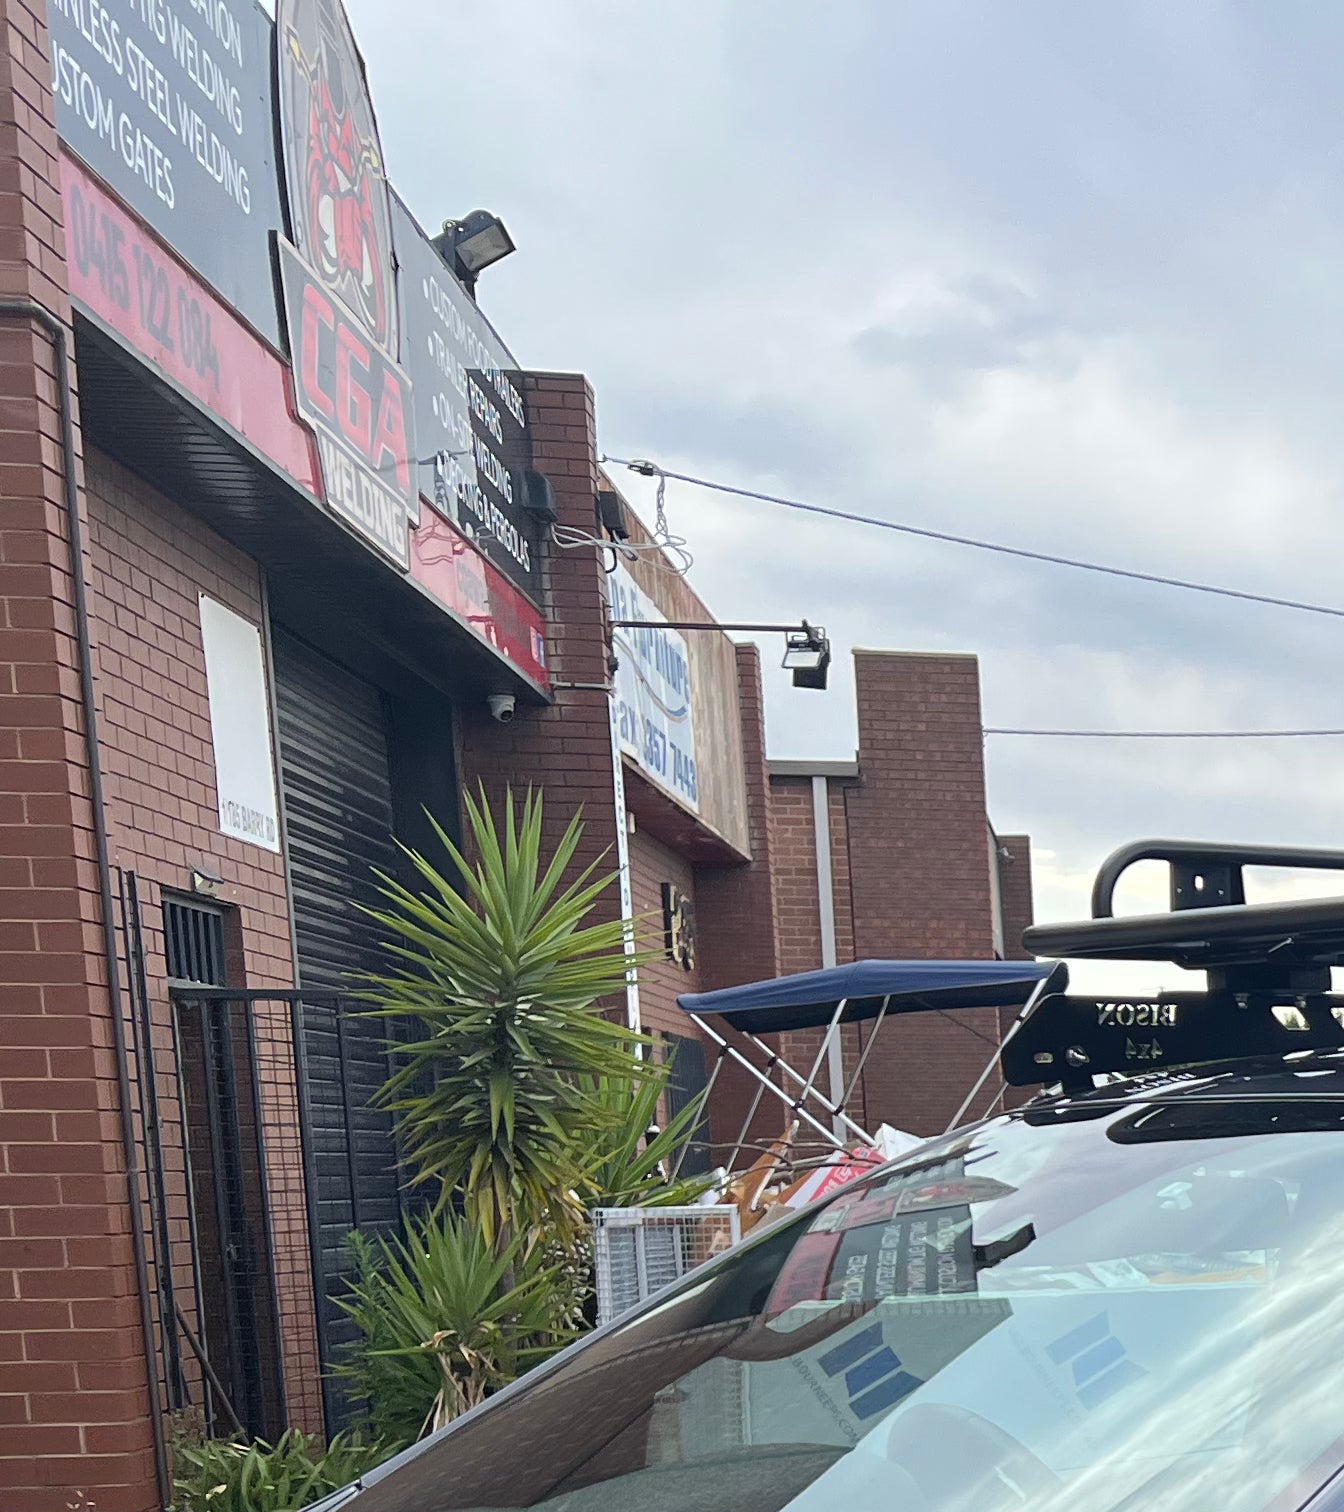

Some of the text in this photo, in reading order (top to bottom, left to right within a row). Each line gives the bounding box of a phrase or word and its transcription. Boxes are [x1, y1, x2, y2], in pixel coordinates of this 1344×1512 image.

[126, 37, 177, 136] STEEL
[175, 92, 251, 215] WELDING
[166, 5, 243, 135] WELDING
[119, 112, 175, 210] GATES
[301, 283, 411, 499] CGA
[320, 433, 406, 557] WELDING
[473, 431, 514, 505] WELDING
